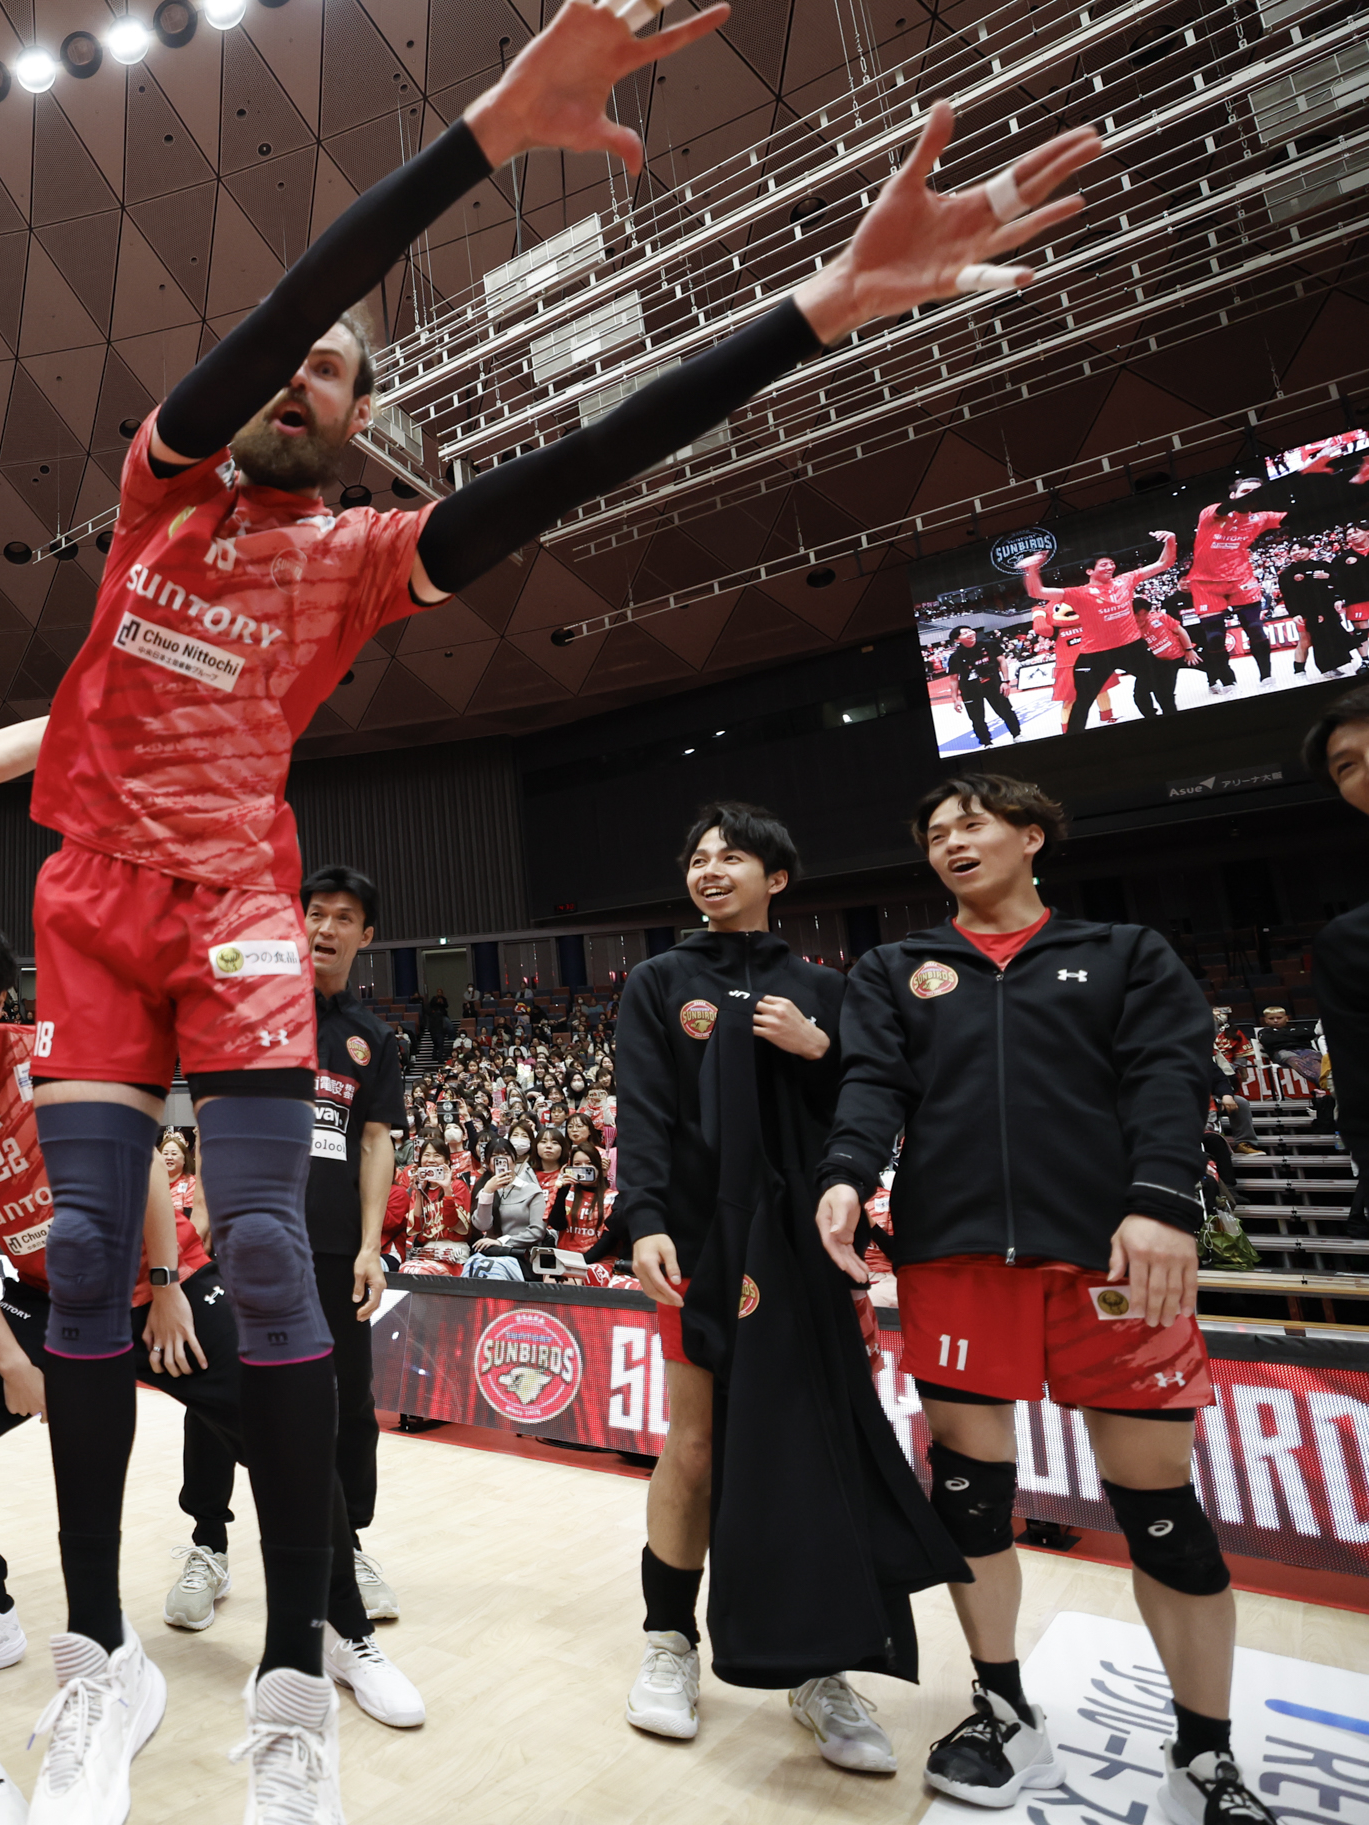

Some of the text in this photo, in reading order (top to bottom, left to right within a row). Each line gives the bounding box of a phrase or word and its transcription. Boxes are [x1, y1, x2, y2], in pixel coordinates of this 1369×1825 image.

[996, 536, 1053, 562] SUNBIRDS
[127, 563, 283, 648] SUNTORY
[143, 629, 240, 677] Chuo Nittochi
[1169, 784, 1203, 797] Asue
[245, 951, 298, 964] つの食品
[913, 972, 955, 990] SUNBIRDS
[34, 1021, 55, 1058] 18
[21, 1230, 47, 1244] Chuo
[481, 1339, 575, 1383] SUNBIRDS
[939, 1334, 969, 1372] 11
